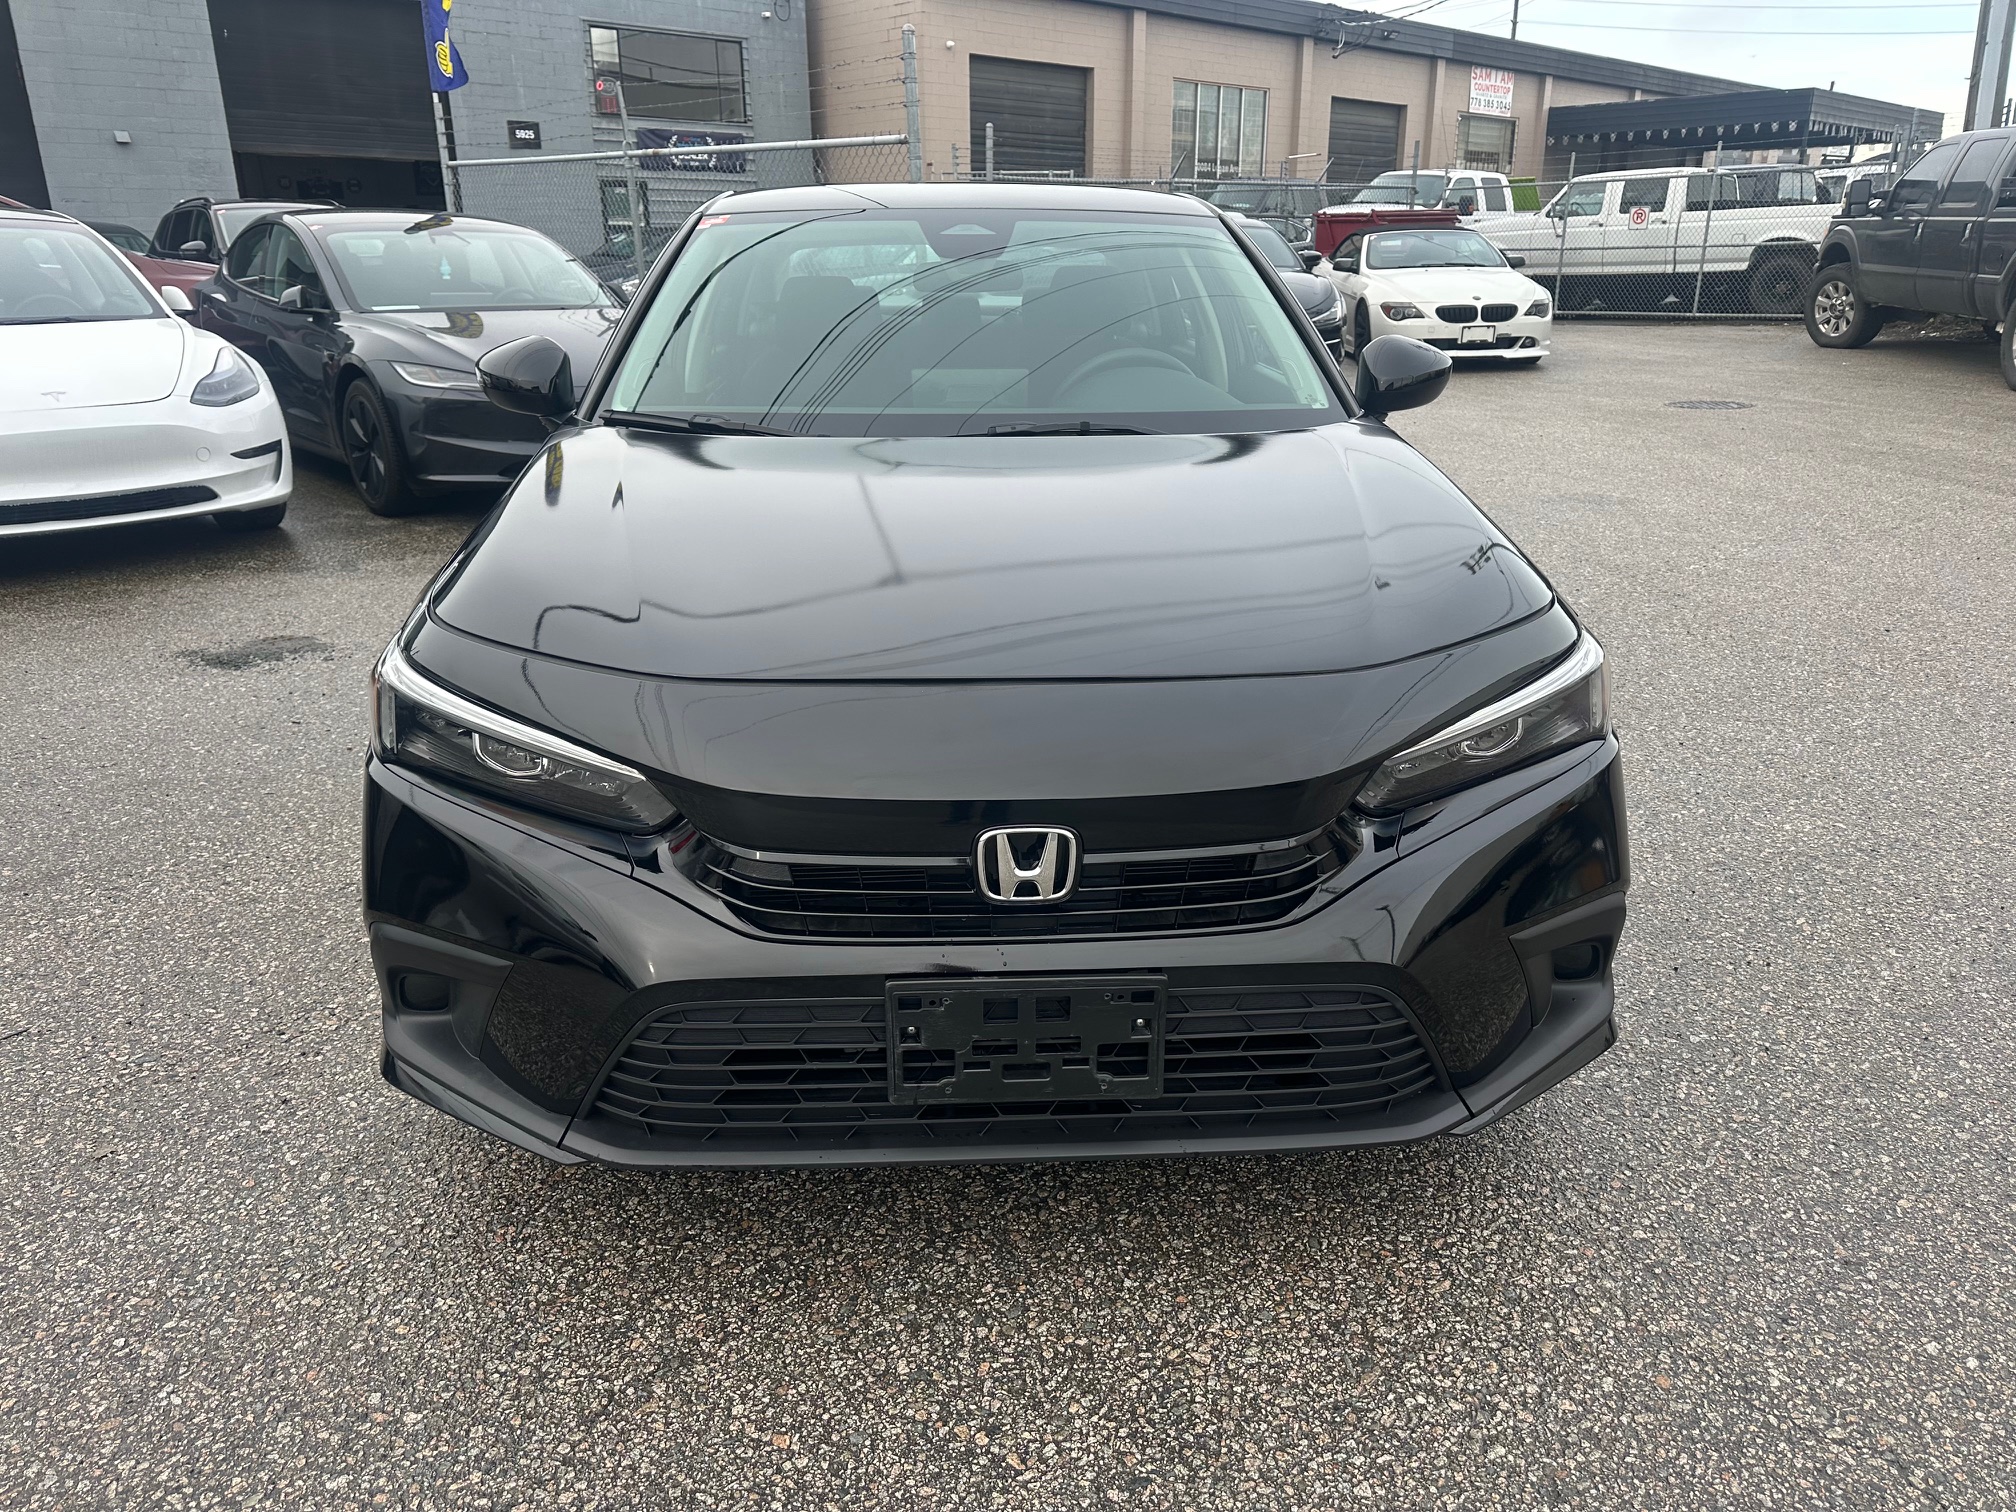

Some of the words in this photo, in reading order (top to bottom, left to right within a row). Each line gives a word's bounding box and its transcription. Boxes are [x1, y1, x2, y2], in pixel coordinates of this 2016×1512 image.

[1472, 65, 1491, 82] SAM
[1495, 69, 1498, 83] I
[1500, 70, 1514, 85] AM
[1474, 82, 1510, 95] COUNTERTOP
[1470, 97, 1481, 107] 778
[1483, 98, 1494, 109] 385
[1496, 100, 1511, 111] 3045
[515, 129, 535, 139] 5925
